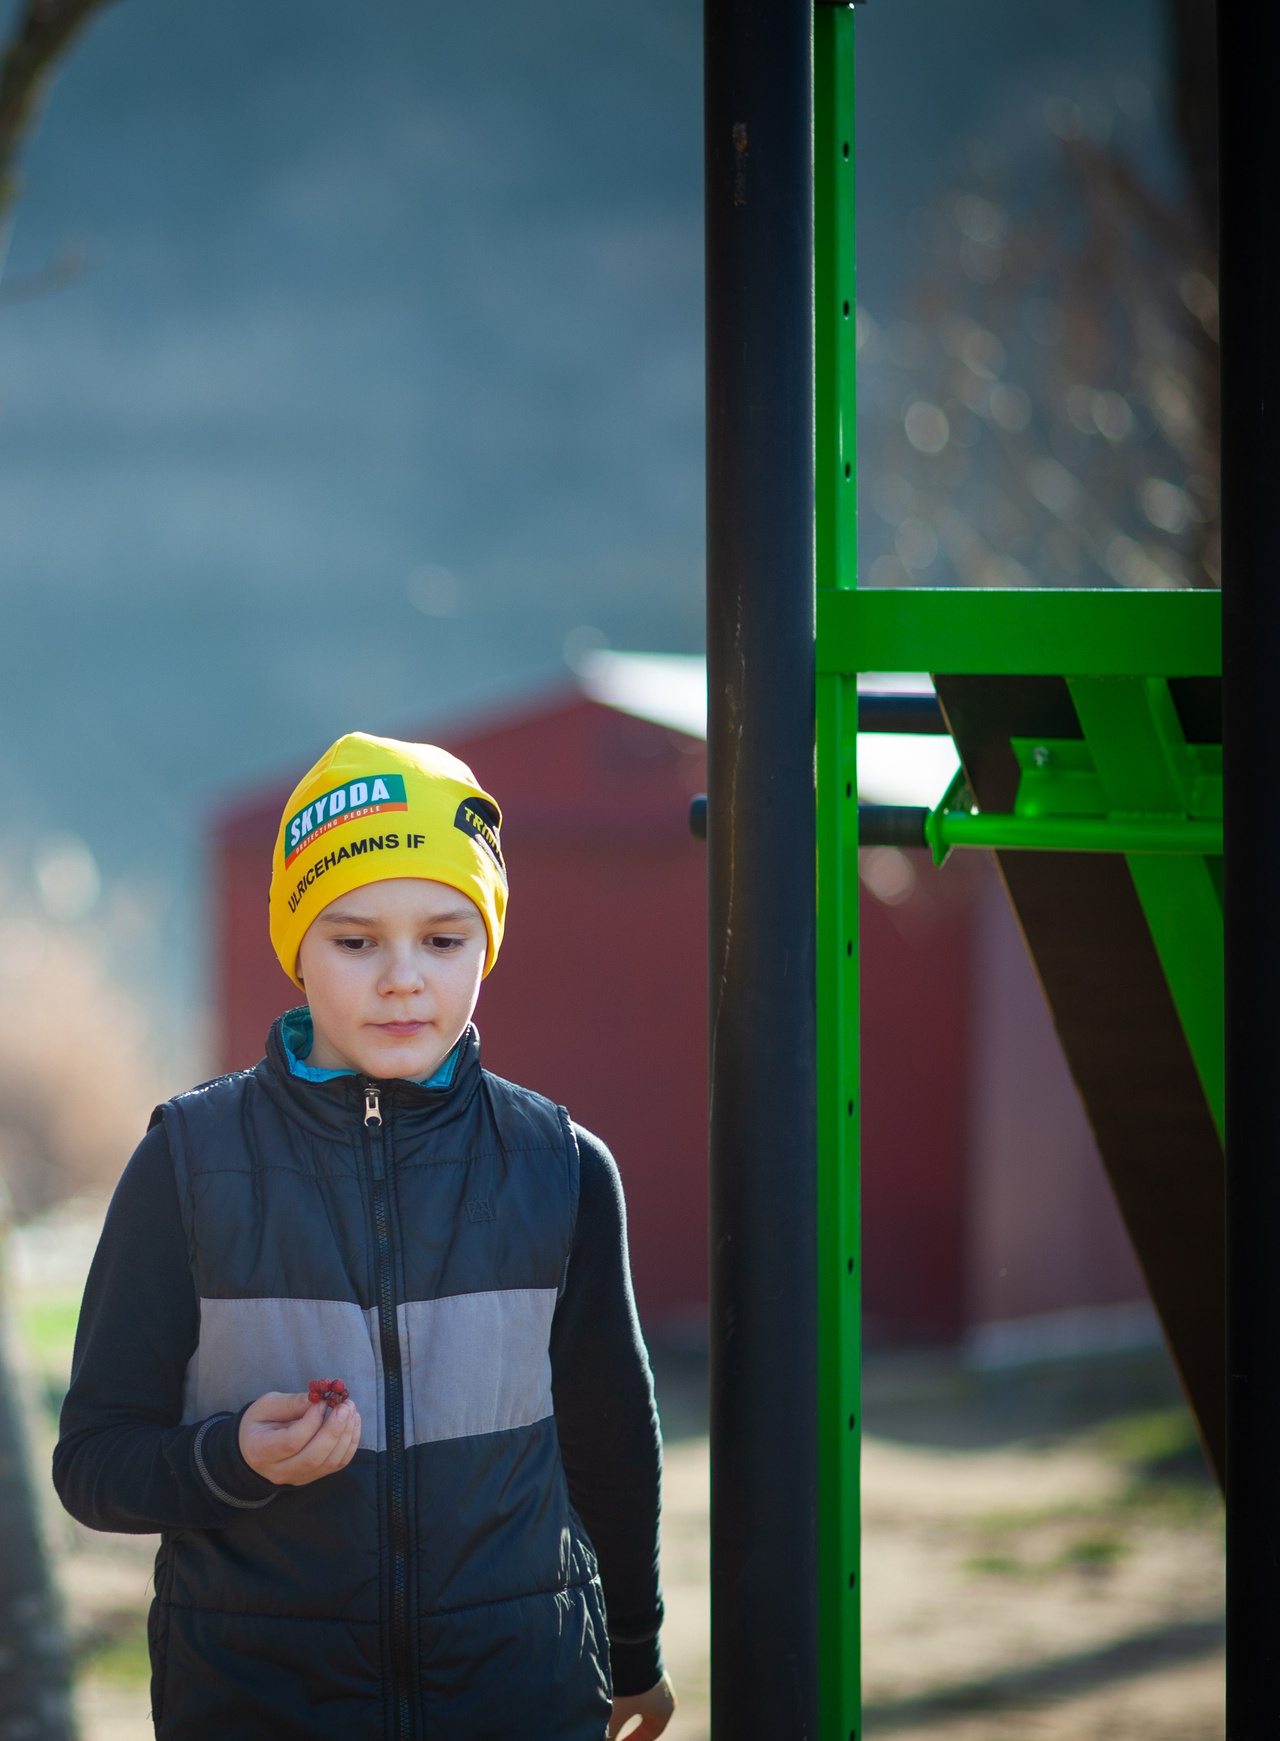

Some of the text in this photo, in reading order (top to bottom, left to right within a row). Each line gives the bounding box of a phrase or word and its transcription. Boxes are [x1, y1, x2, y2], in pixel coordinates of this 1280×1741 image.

[290, 778, 390, 847] SKYDDA
[295, 805, 381, 854] PROTECTING PEOPLE
[287, 833, 426, 914] ULRICEHAMNS IF
